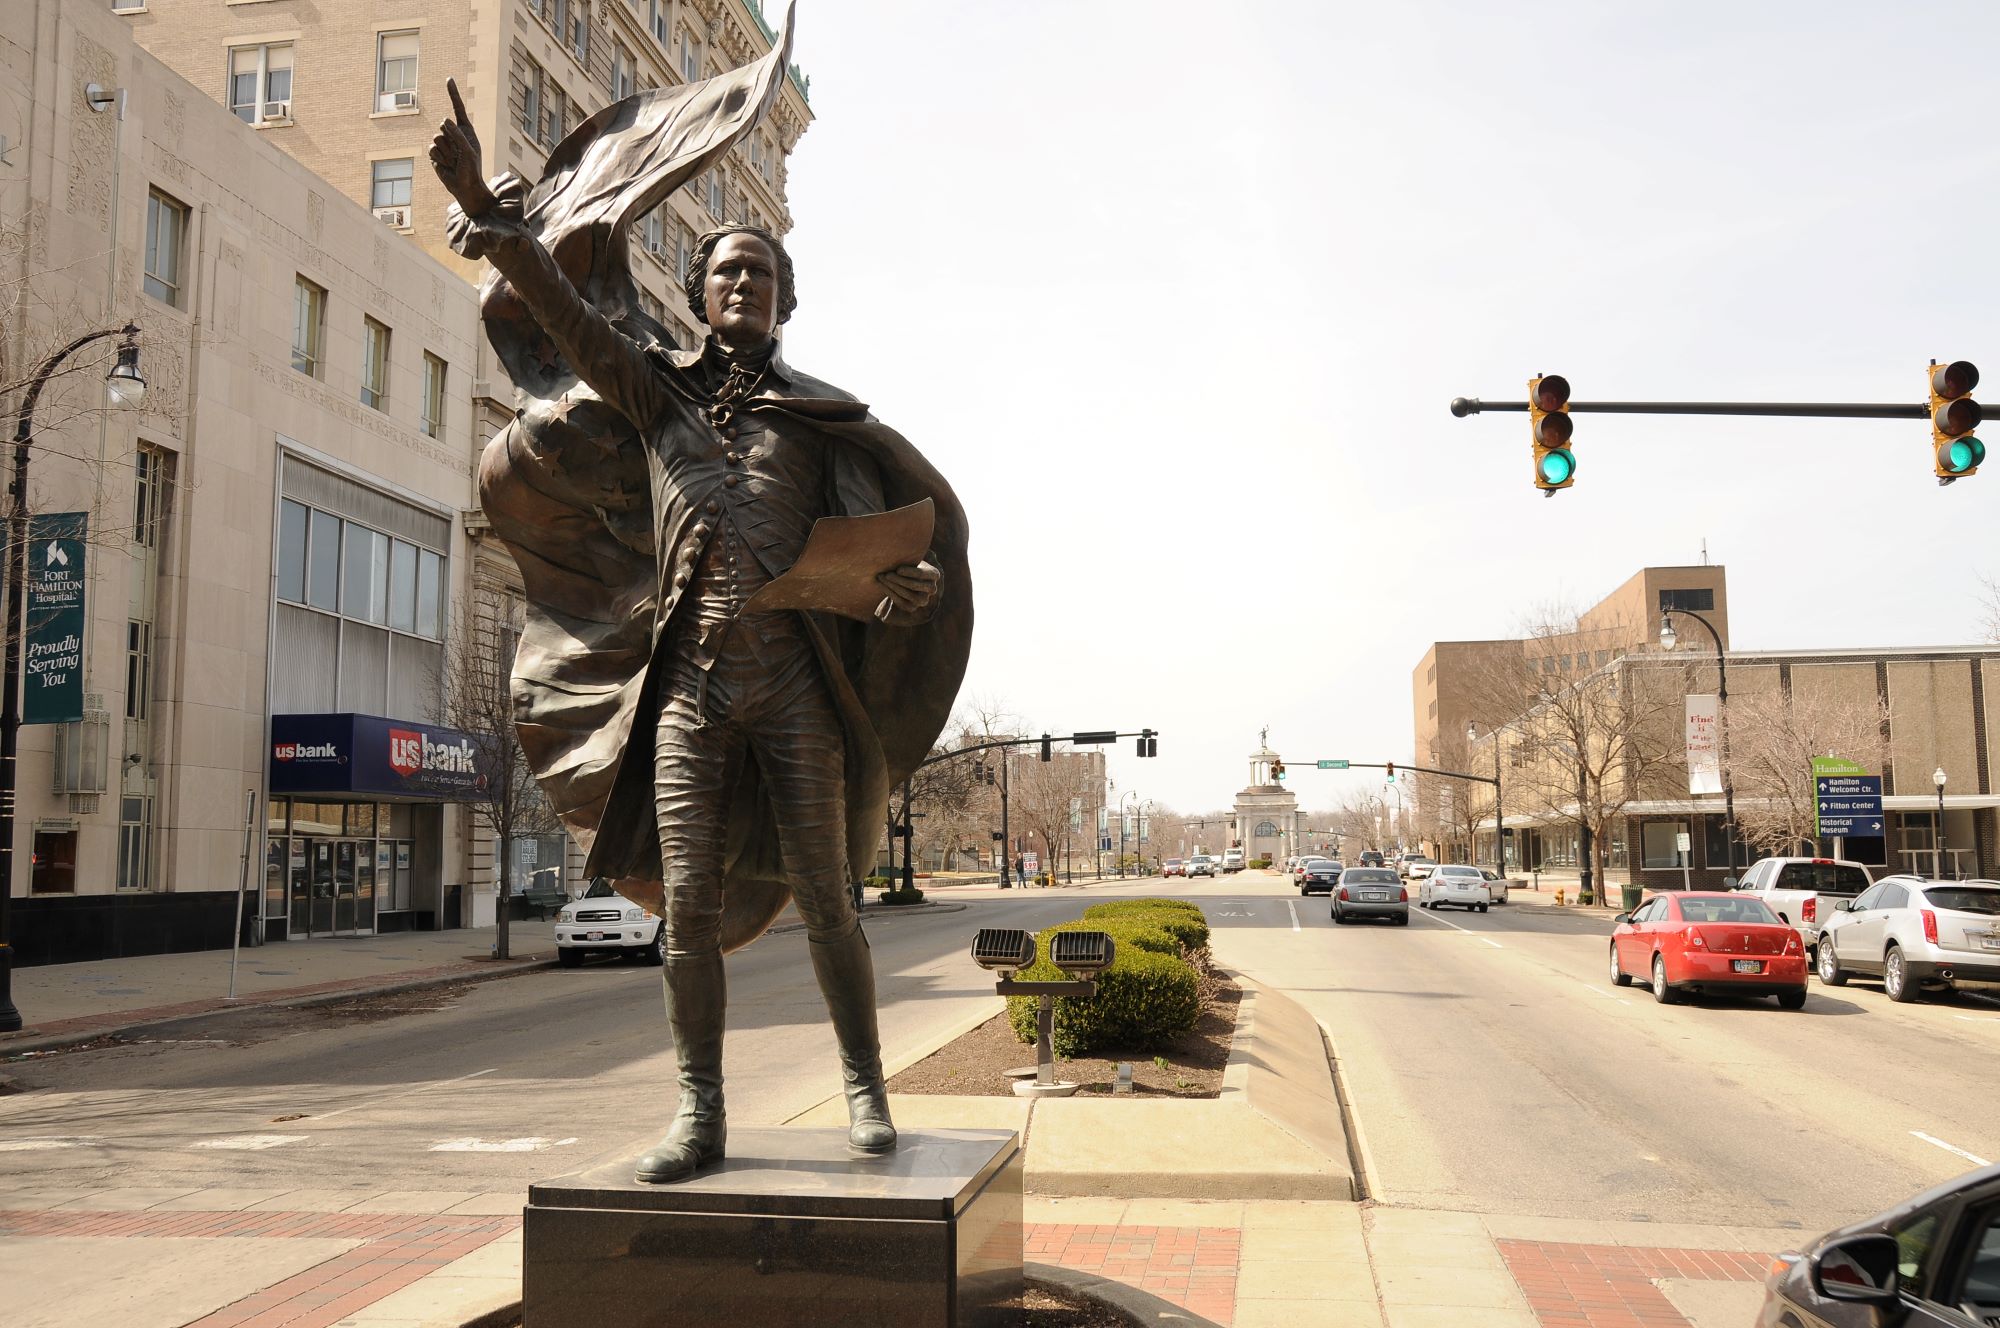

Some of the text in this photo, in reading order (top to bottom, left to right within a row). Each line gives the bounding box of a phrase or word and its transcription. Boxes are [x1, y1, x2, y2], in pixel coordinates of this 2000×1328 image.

[44, 570, 70, 581] FORT
[29, 580, 83, 593] HAMILTON
[27, 634, 80, 658] Proudly
[27, 653, 79, 674] Serving
[42, 672, 66, 688] You
[1816, 764, 1859, 773] Hamilton
[1828, 778, 1860, 786] Hamilton
[1829, 786, 1860, 794] Welcome
[1829, 802, 1850, 810] Fitton
[1820, 818, 1853, 827] Historical
